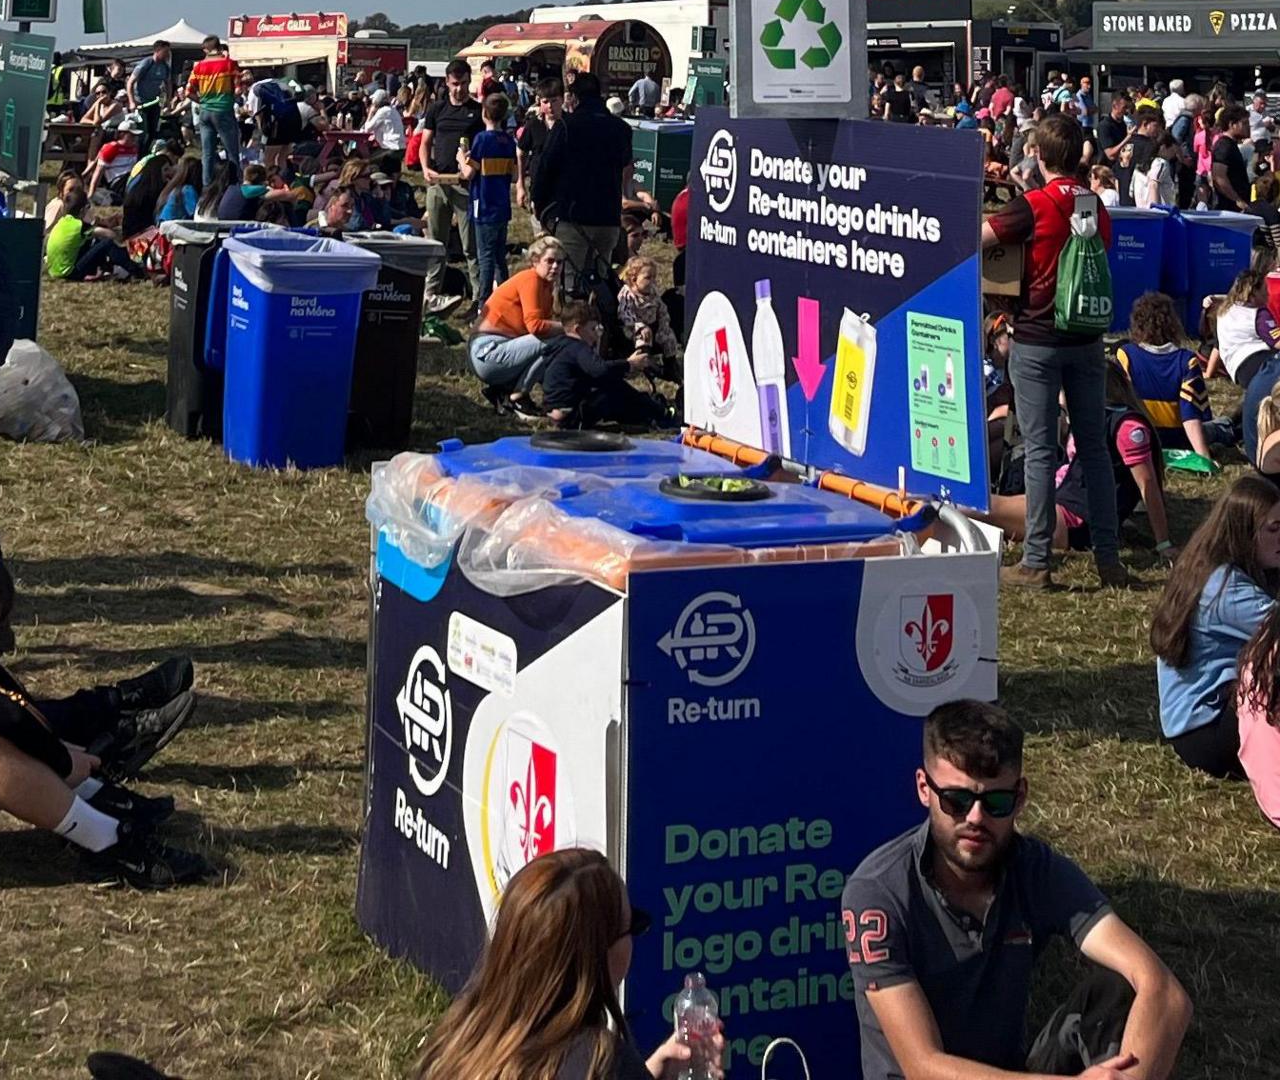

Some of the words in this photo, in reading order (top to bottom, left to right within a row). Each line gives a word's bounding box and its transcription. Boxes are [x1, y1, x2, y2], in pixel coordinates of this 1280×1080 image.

[287, 19, 312, 31] GRILL
[1102, 14, 1144, 33] STONE
[1148, 14, 1192, 33] BAKED
[1231, 12, 1277, 31] PIZZA
[608, 46, 634, 60] GRASS
[635, 47, 650, 61] FED
[750, 147, 813, 184] Donate
[817, 162, 866, 192] your
[748, 184, 818, 225] Re-turn
[820, 195, 864, 236] logo
[865, 202, 942, 244] drinks
[699, 215, 737, 246] Re-turn
[747, 228, 848, 269] containers
[851, 239, 905, 279] here
[290, 308, 304, 317] na
[306, 305, 336, 317] Móna
[291, 296, 317, 307] Bord
[1078, 294, 1112, 315] FBD
[668, 696, 761, 724] Re-turn
[394, 787, 450, 870] Re-turn
[664, 817, 833, 864] Donate
[663, 875, 779, 927] your
[662, 931, 763, 974] logo
